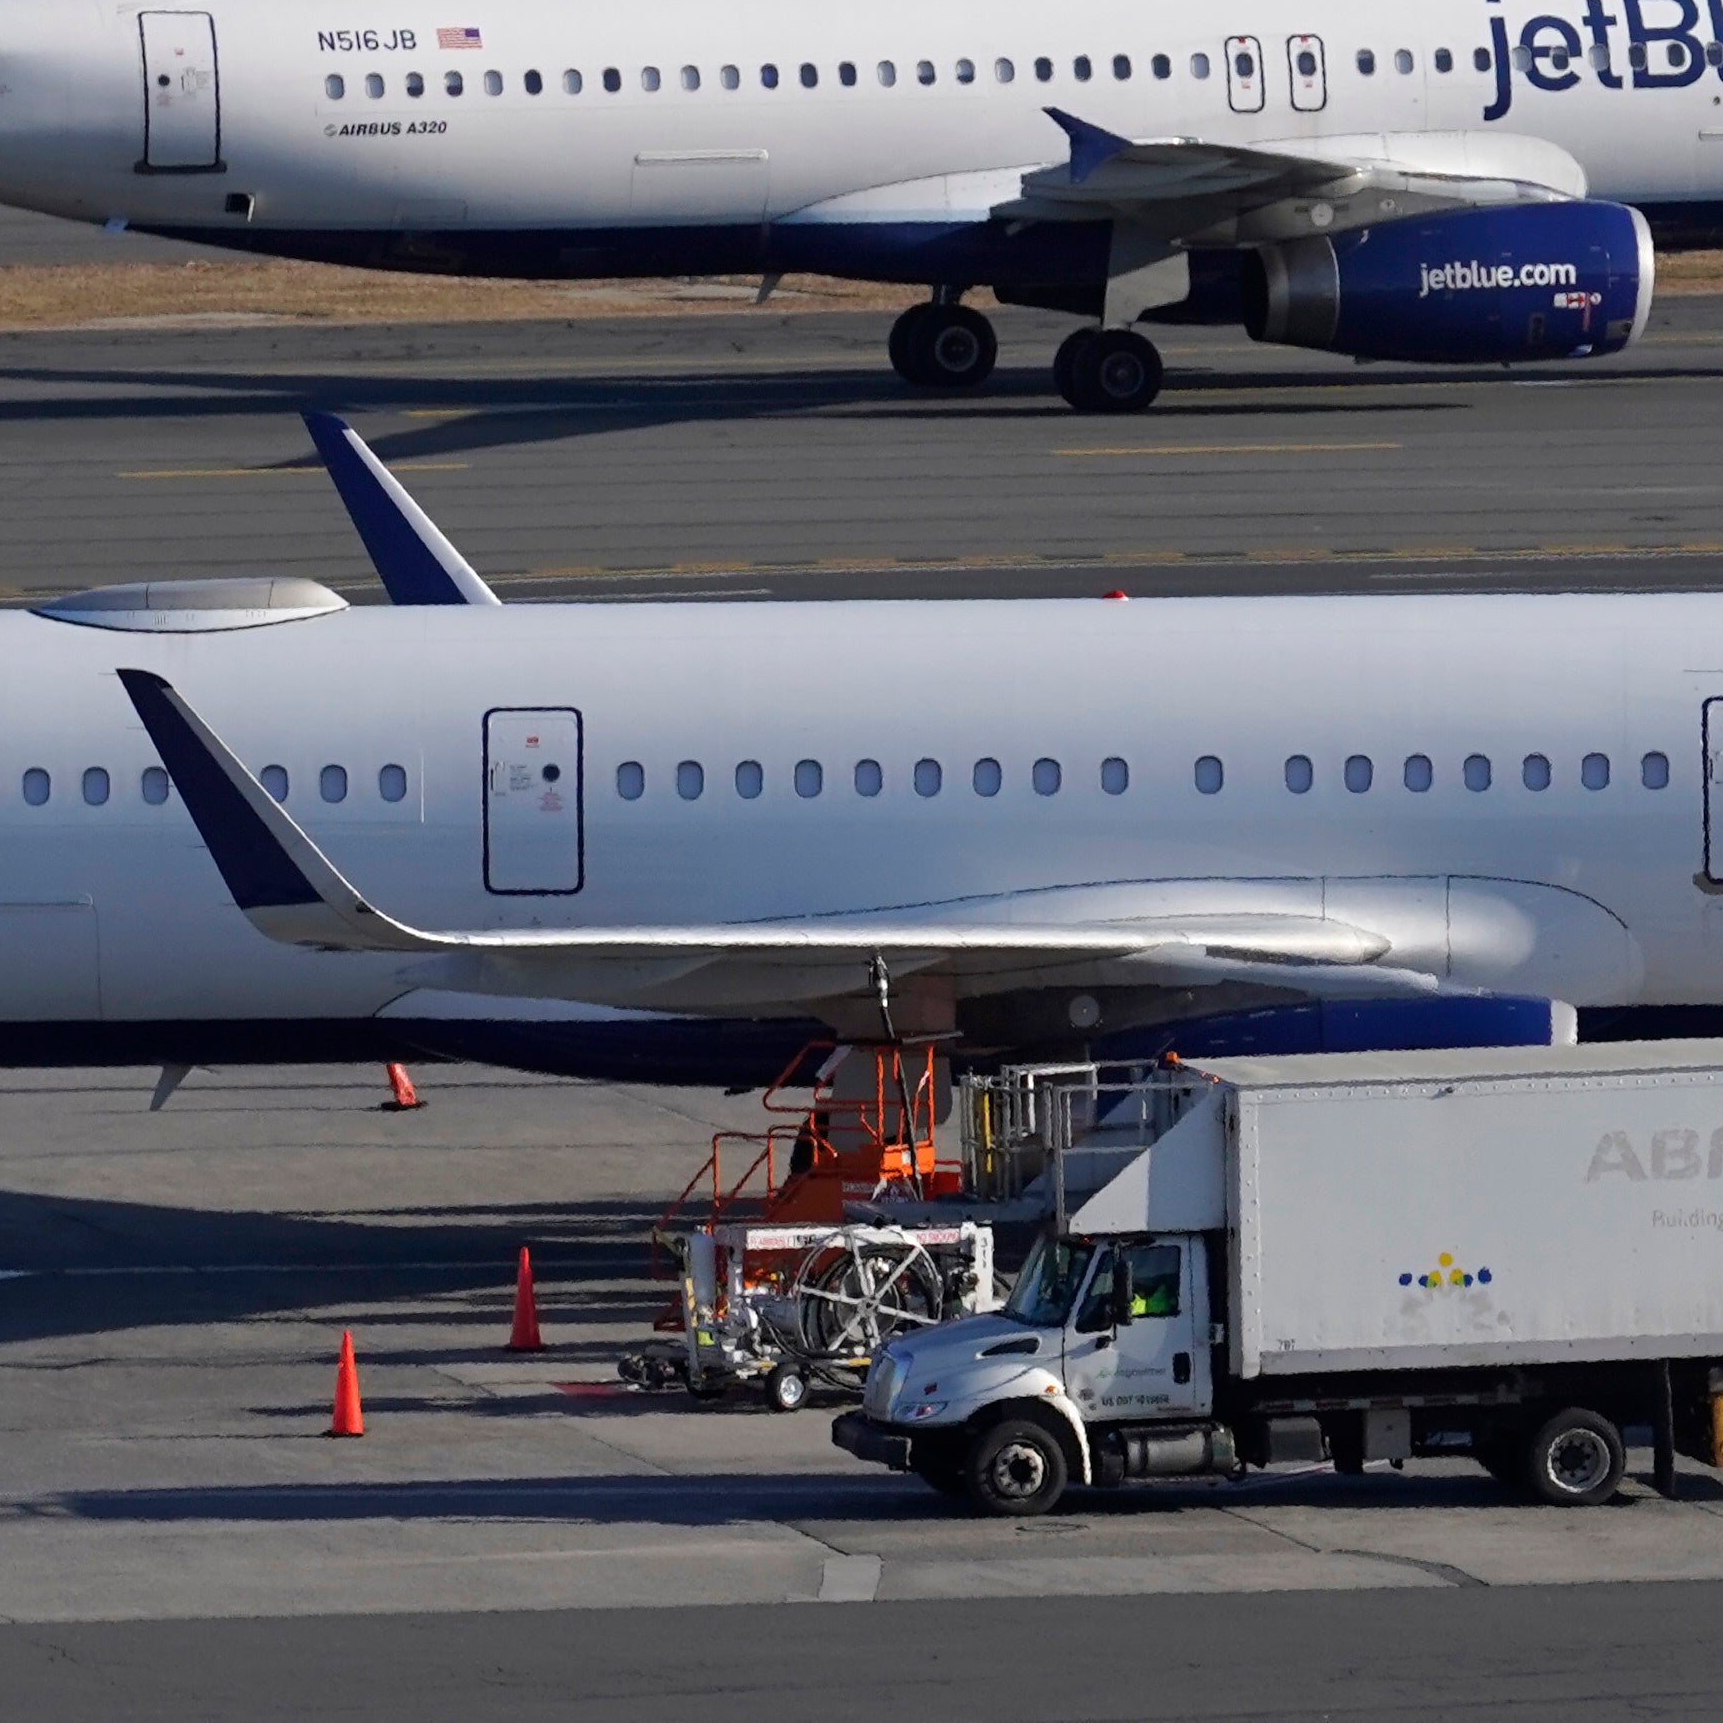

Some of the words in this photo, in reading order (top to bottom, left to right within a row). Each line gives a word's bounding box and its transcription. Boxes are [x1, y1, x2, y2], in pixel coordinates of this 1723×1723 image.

[318, 29, 417, 52] N516JB
[339, 122, 401, 136] AIRBUS
[406, 121, 448, 134] A320
[1419, 260, 1577, 299] jetblue.com
